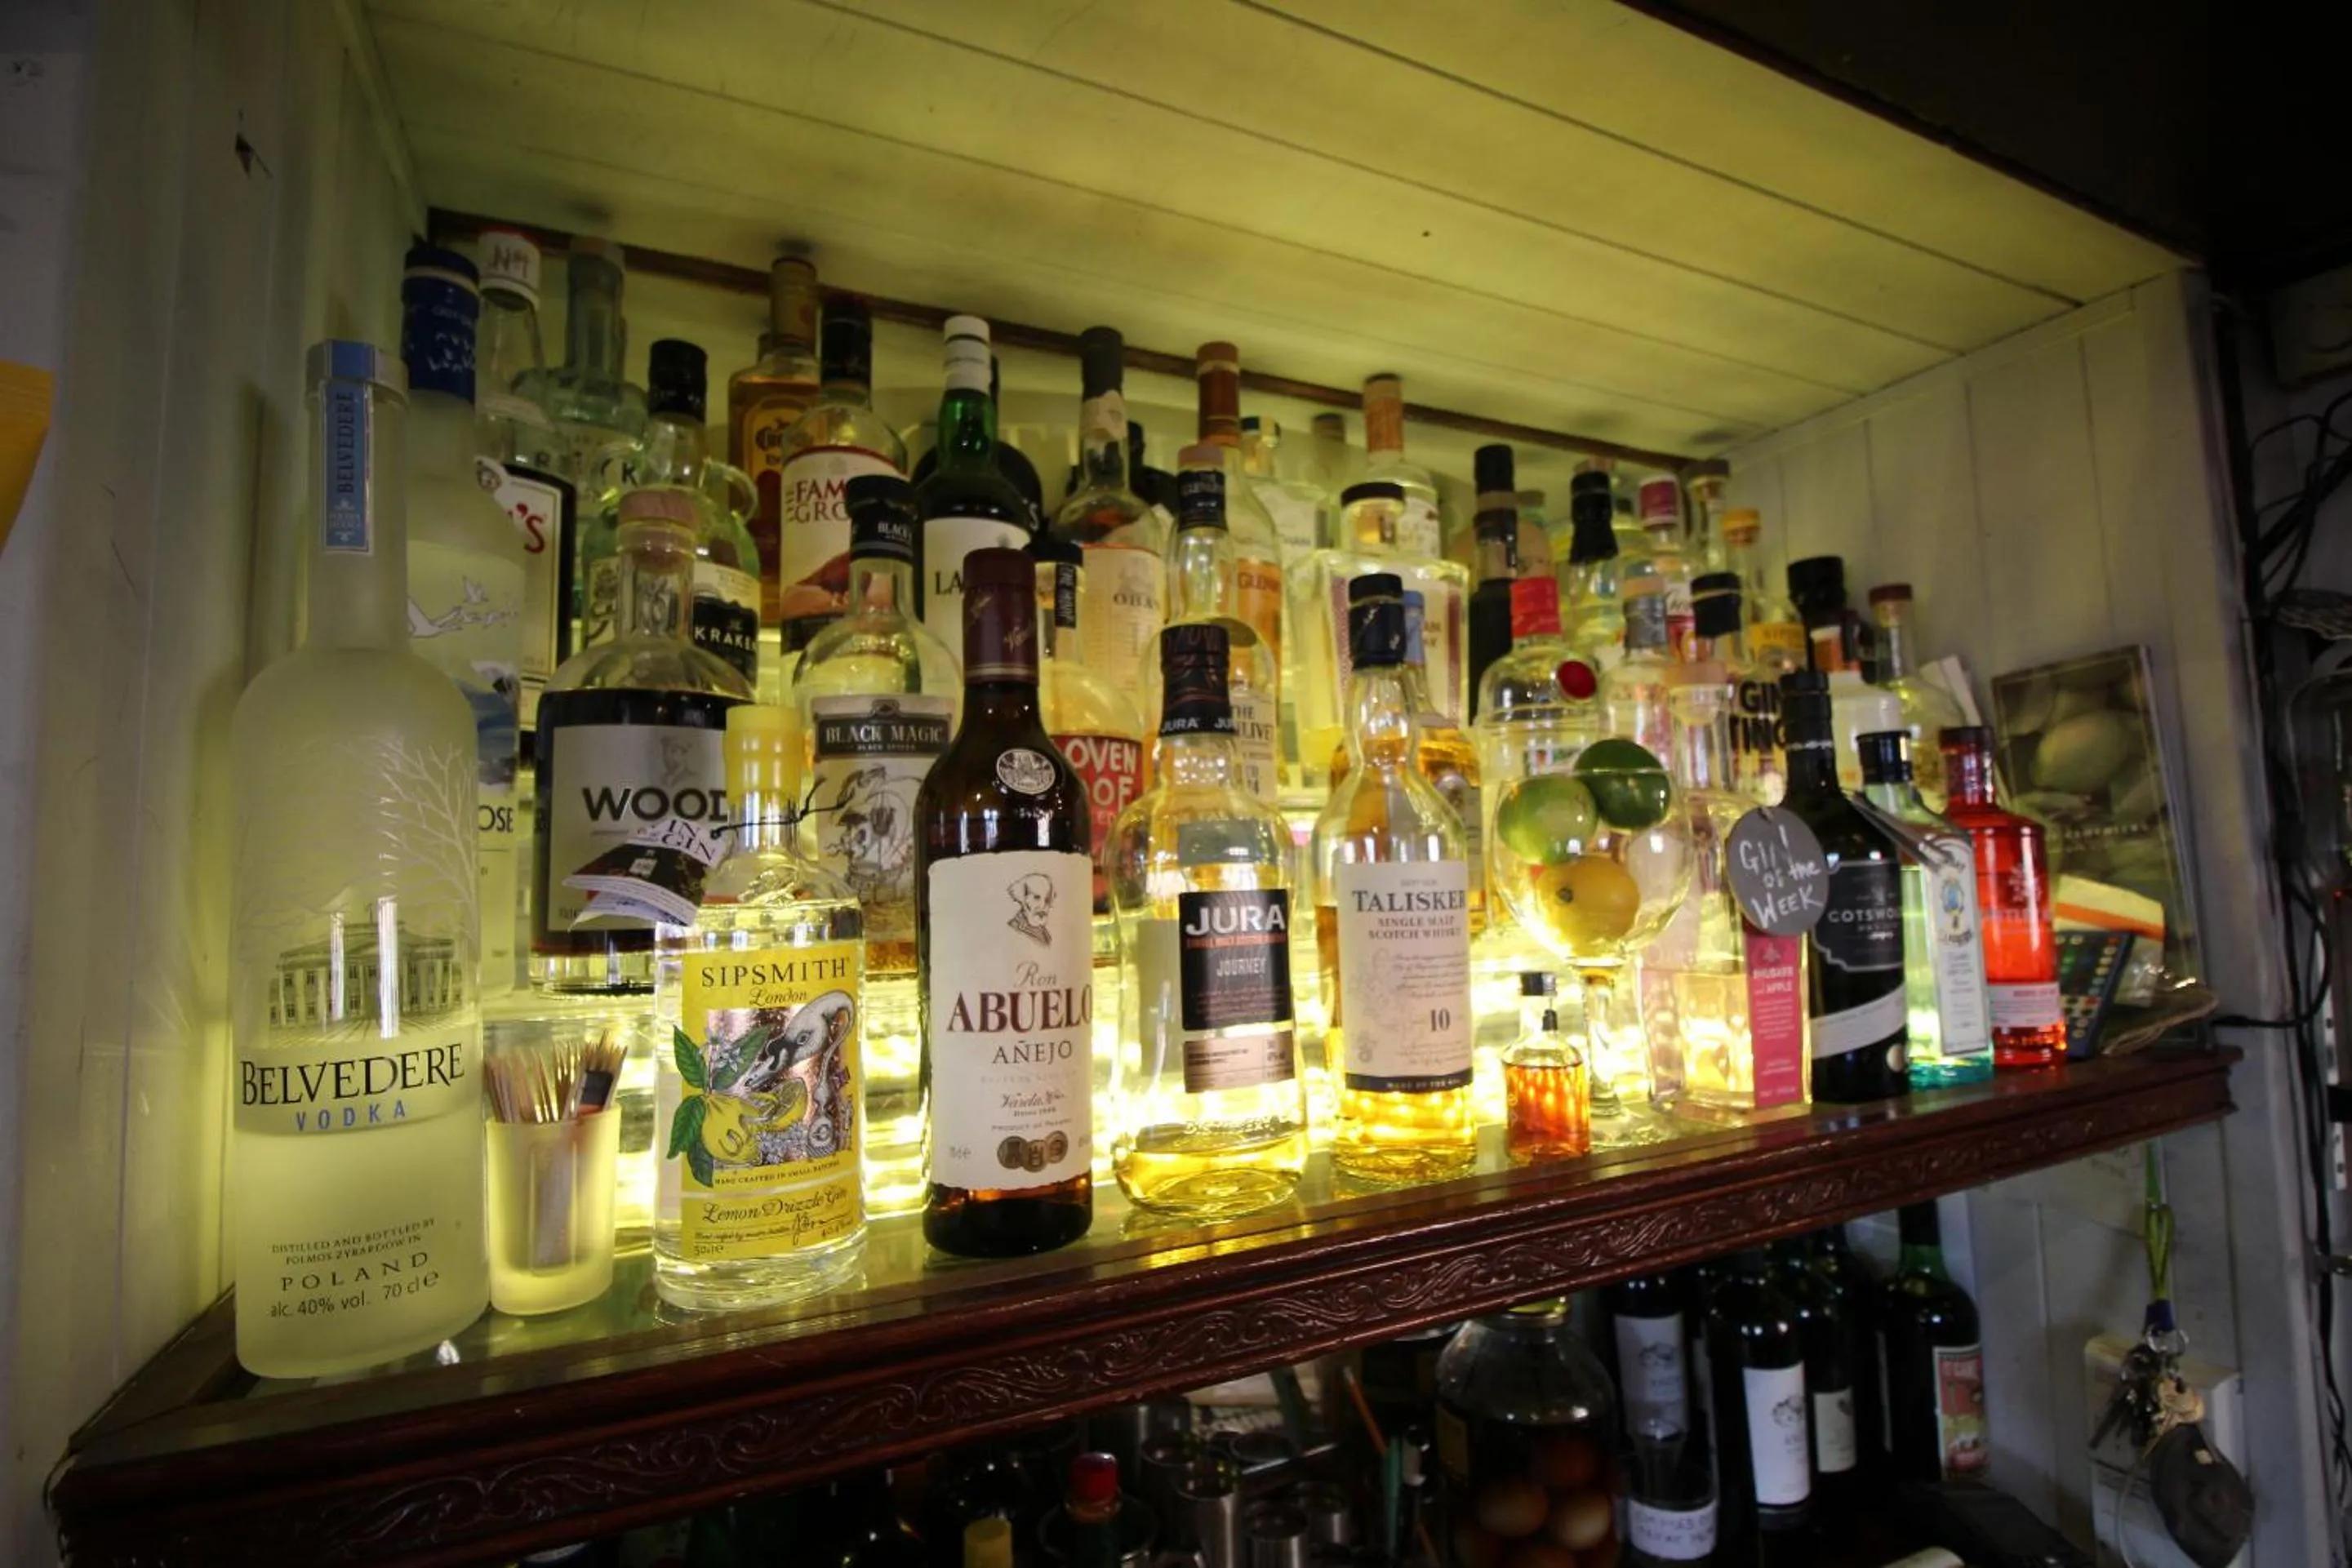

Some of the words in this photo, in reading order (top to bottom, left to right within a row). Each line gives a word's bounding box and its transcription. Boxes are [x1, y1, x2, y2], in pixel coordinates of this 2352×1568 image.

[795, 478, 847, 503] FAM
[825, 724, 882, 744] BLACK
[890, 725, 943, 743] MAGIC
[1162, 717, 1198, 733] JURA
[1065, 737, 1138, 774] OVEN
[478, 805, 514, 832] OSE
[1750, 883, 1825, 929] WEEK
[1185, 904, 1287, 936] JURA
[1377, 916, 1424, 927] SINGLE
[1367, 928, 1420, 940] SCOTCH
[701, 957, 847, 988] SIPSMITH
[1014, 961, 1059, 988] Ron
[1216, 957, 1266, 977] JOURNEY
[749, 985, 807, 1007] London
[1430, 1008, 1451, 1033] 10
[992, 1040, 1073, 1065] AÑEJO
[240, 1043, 465, 1106] BELVEDERE
[296, 1099, 406, 1131] VODKA
[738, 1173, 776, 1184] CRAFTED
[702, 1202, 759, 1224] Lemon
[761, 1191, 824, 1216] Drizzle
[272, 1241, 330, 1254] DISTILLED
[333, 1236, 362, 1249] AND
[365, 1222, 420, 1243] BOTTLED
[407, 1234, 422, 1244] IN
[280, 1251, 428, 1291] POLAND
[296, 1296, 336, 1315] 40%
[382, 1282, 402, 1300] 70
